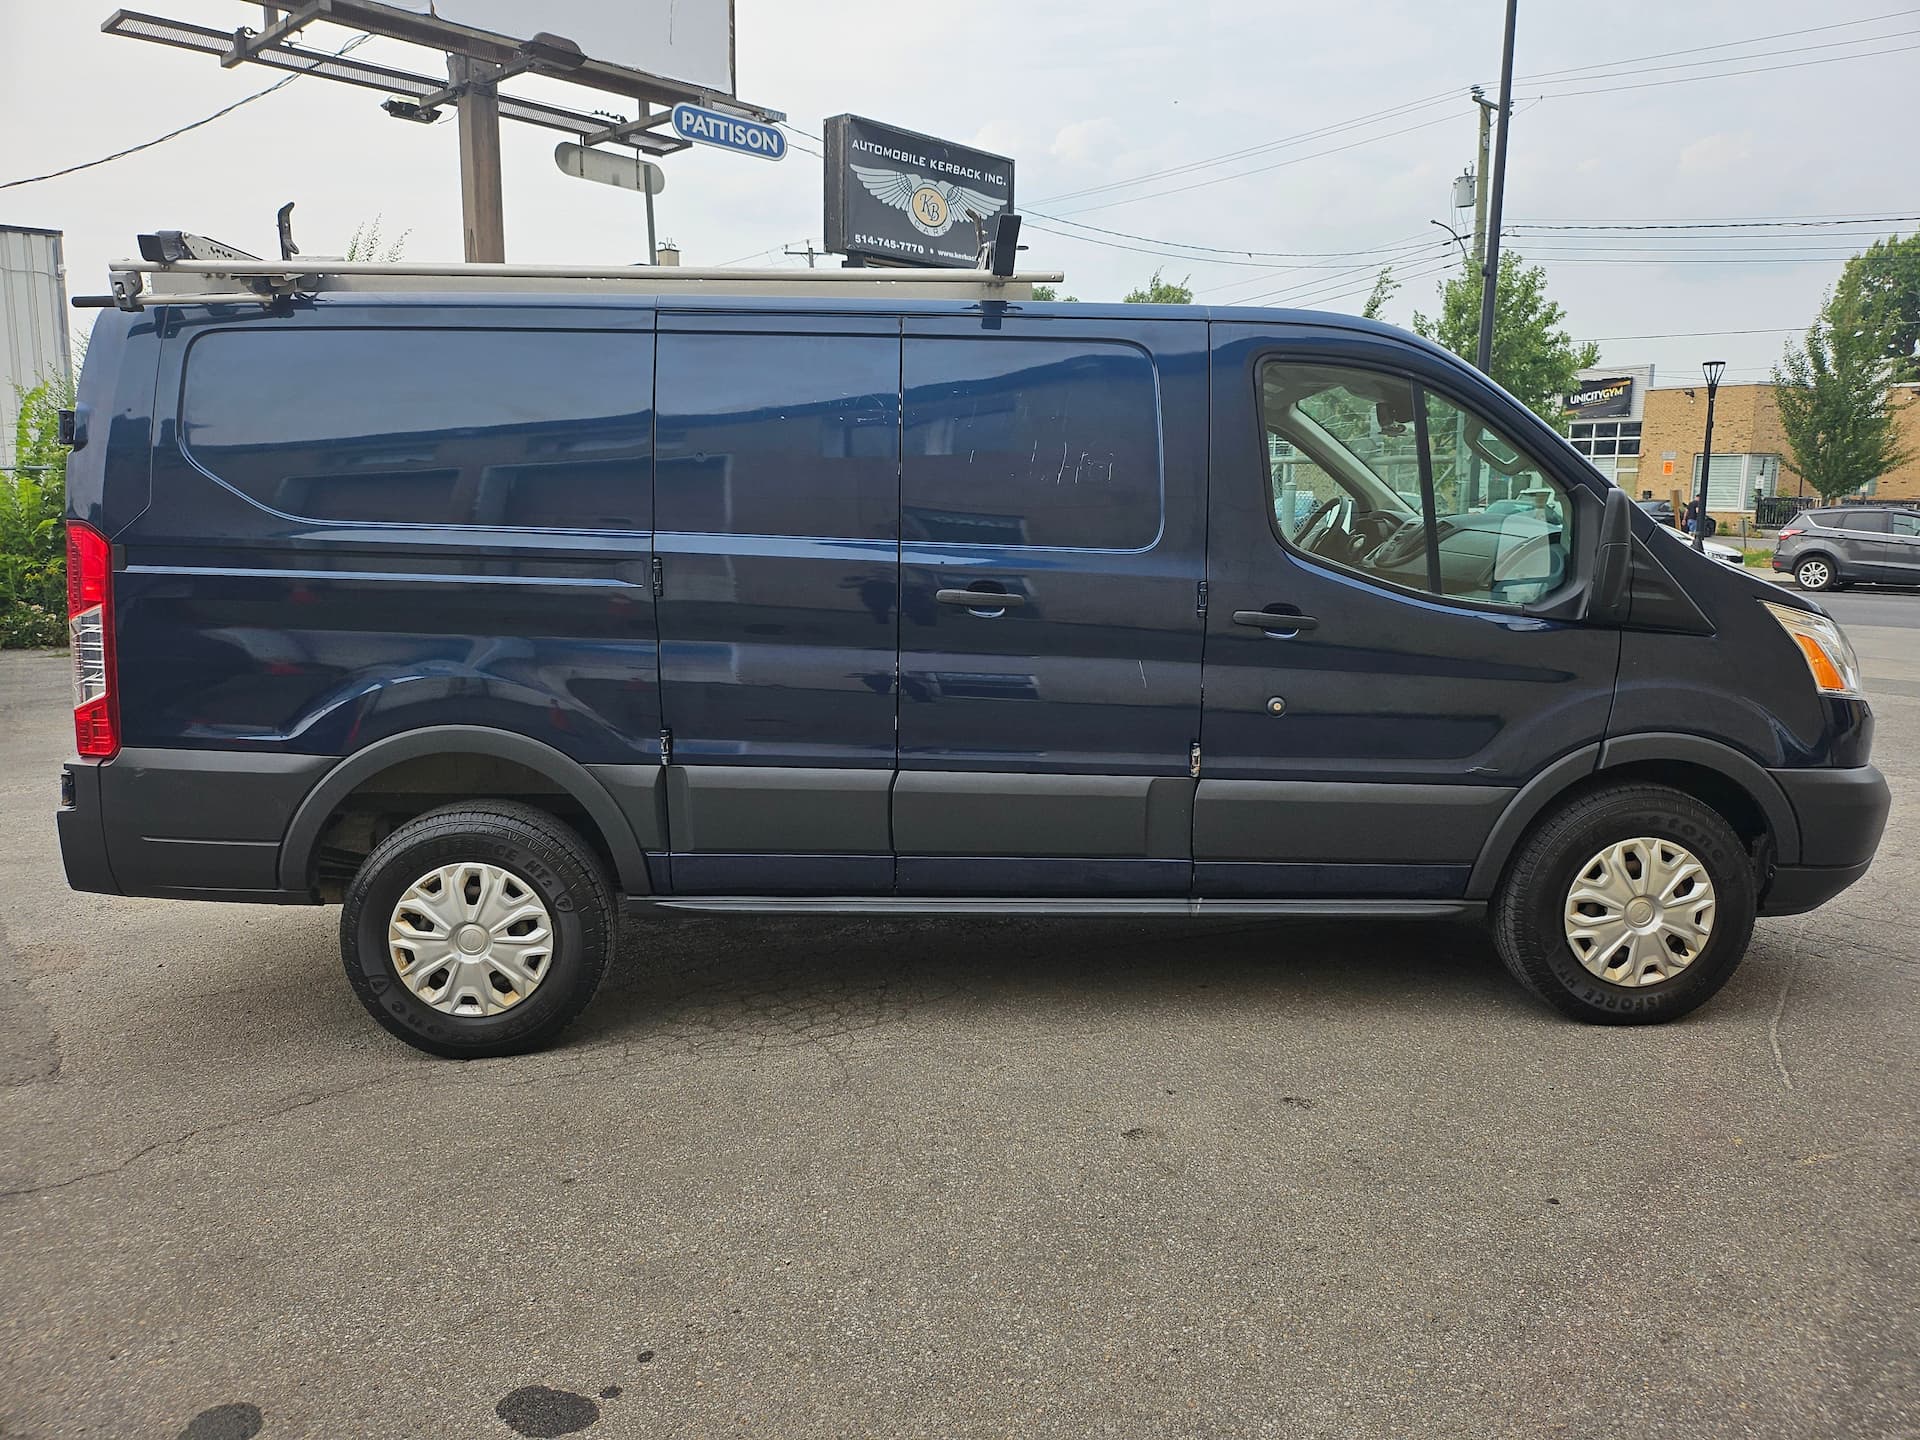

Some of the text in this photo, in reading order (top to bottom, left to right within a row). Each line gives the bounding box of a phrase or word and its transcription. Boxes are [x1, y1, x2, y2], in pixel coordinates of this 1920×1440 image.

[681, 111, 778, 154] PATTISON
[851, 139, 1007, 186] AUTOMOBILE KERBACK INC.
[914, 220, 948, 235] CARS
[855, 234, 925, 254] 514-745-7770
